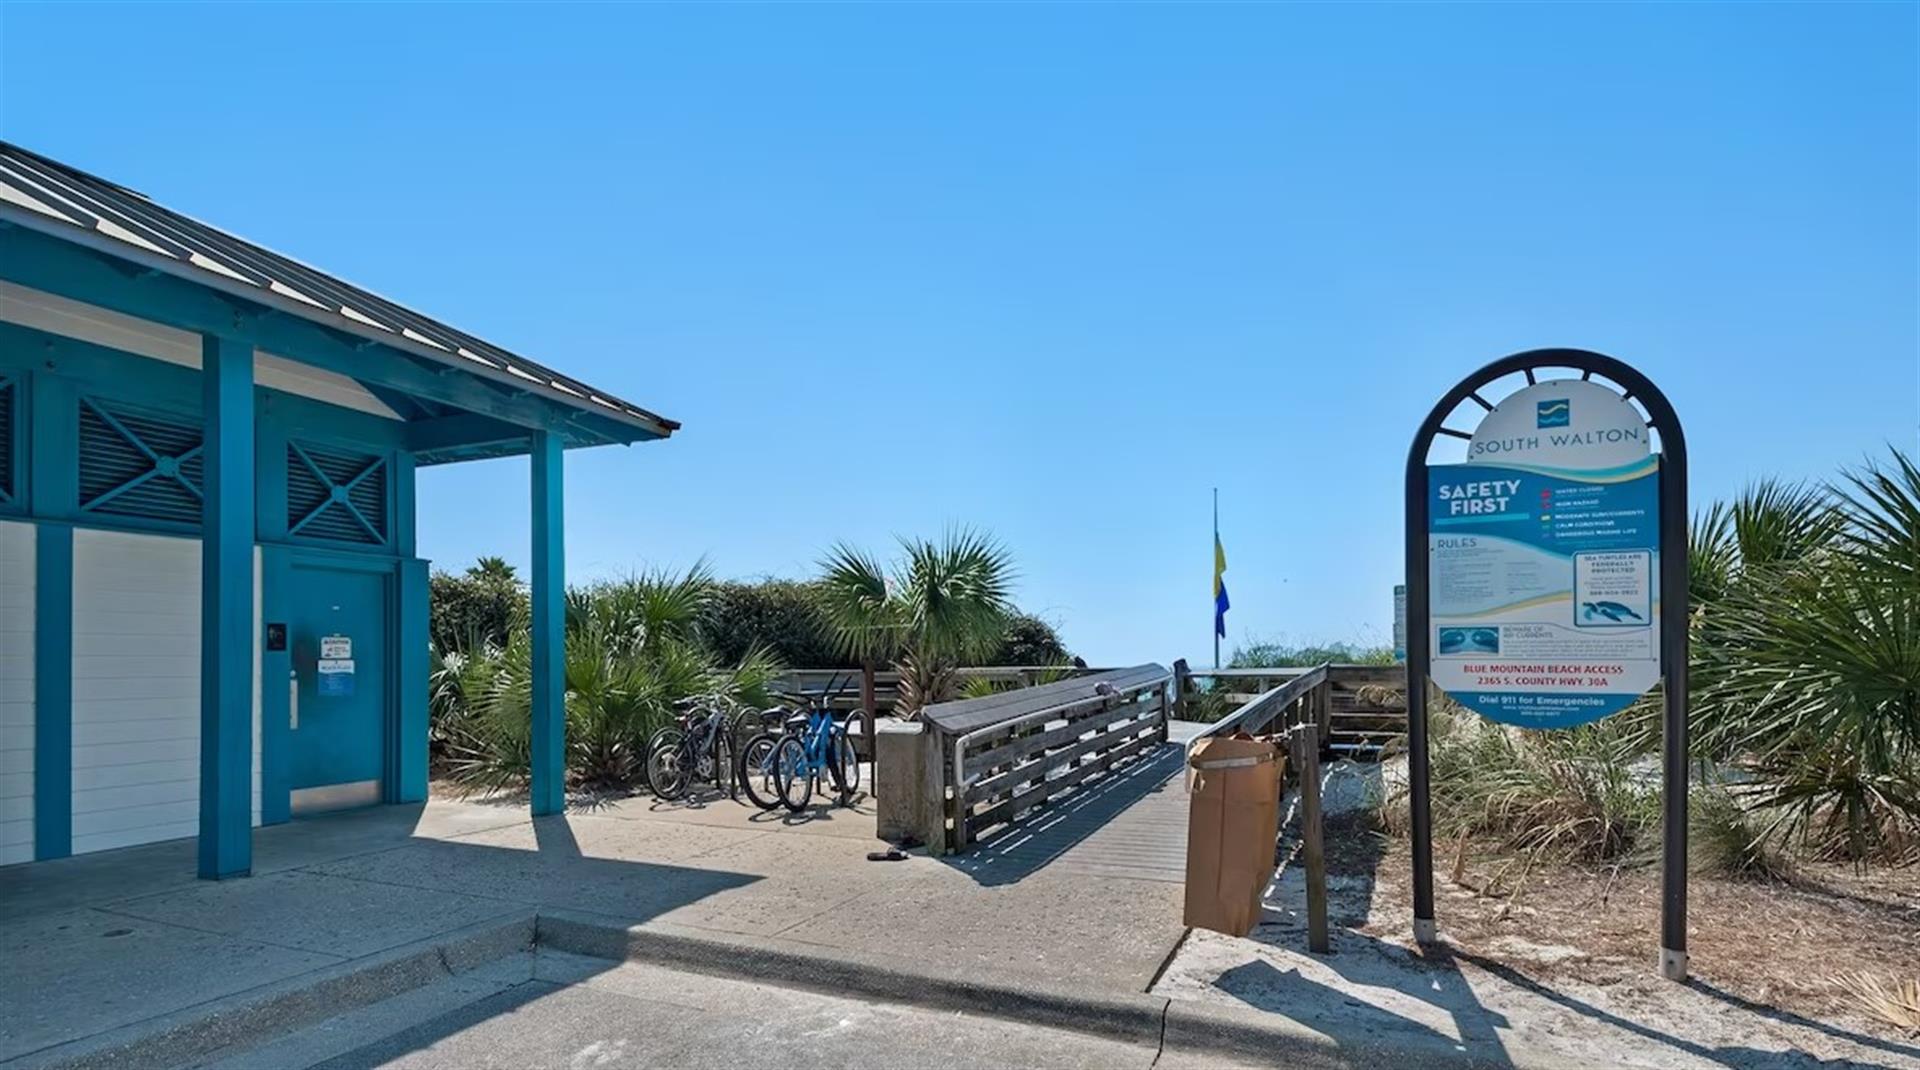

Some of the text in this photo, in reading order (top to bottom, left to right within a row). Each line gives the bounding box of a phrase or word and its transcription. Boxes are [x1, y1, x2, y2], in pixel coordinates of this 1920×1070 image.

[1475, 428, 1639, 454] SOUTH WALTON
[1439, 480, 1521, 500] SAFETY
[1451, 497, 1509, 515] FIRST
[1438, 538, 1477, 549] RULES
[1464, 664, 1624, 674] BLUE MOUNTAIN BEACH ACCESS
[1478, 676, 1608, 687] 2365 S. COUNTY HWY. 30A
[1479, 695, 1606, 707] Dial 911 for Emergencies
